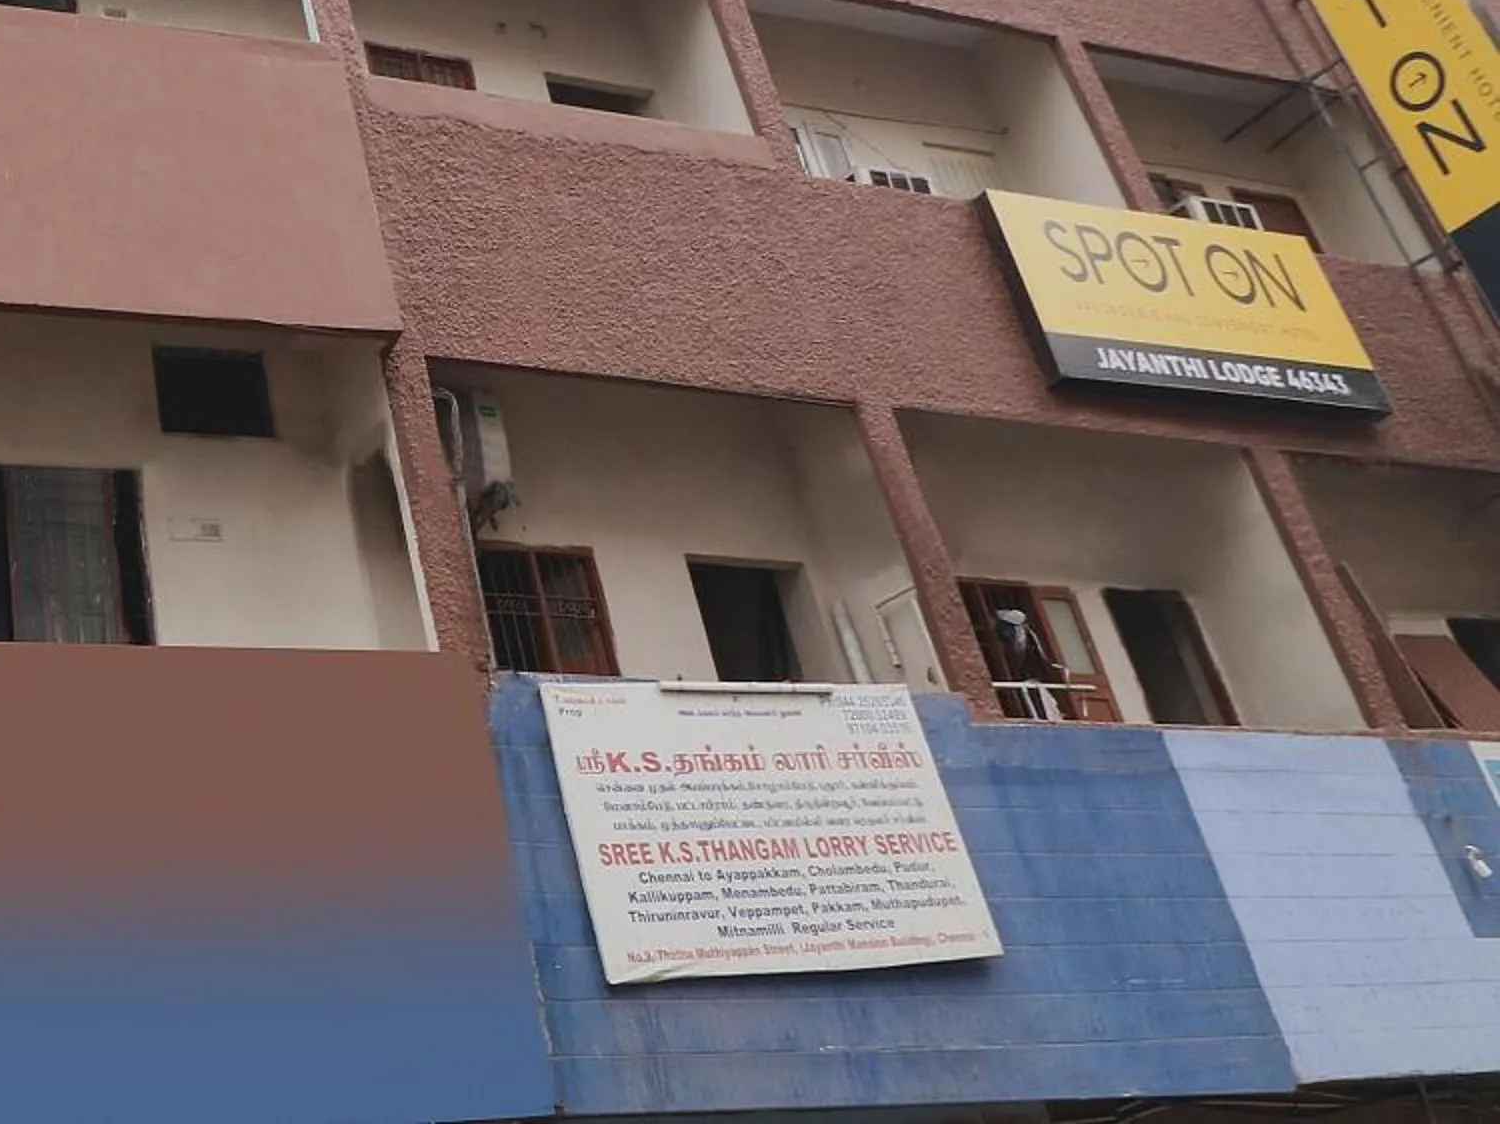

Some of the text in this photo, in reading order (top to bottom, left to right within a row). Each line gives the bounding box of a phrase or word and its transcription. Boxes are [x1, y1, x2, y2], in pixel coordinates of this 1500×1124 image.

[1390, 51, 1488, 176] ON
[1044, 220, 1307, 313] SPOT ON
[1097, 347, 1351, 396] JAYANTHI LODGE 46343
[599, 830, 958, 866] SREE K.S.THANGAM LORRY SERVICE
[638, 870, 694, 884] Chennai
[699, 869, 713, 881] to
[792, 920, 843, 936] Regular
[846, 917, 895, 932] Service
